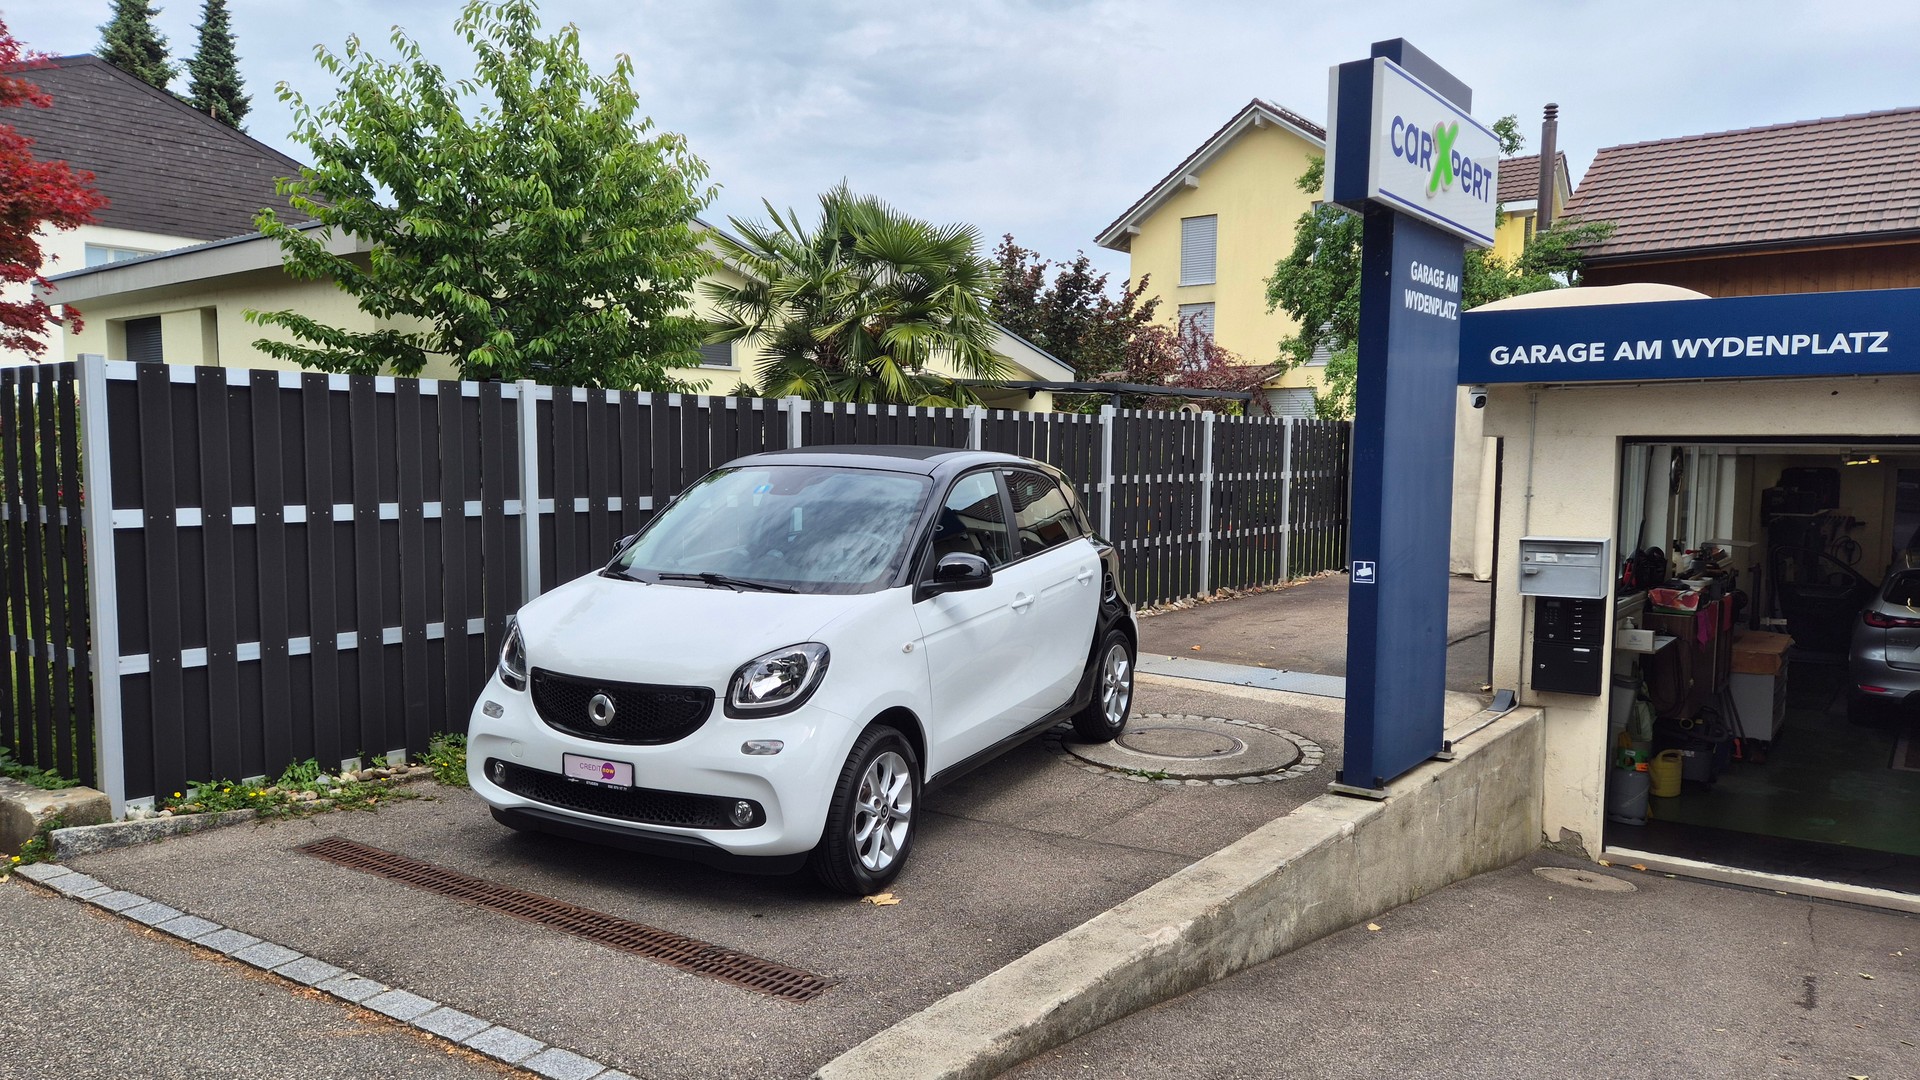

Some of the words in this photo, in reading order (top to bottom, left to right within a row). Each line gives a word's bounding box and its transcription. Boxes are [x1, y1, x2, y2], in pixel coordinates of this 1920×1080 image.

[1411, 261, 1445, 289] GARAGE
[1445, 273, 1459, 293] AM
[1405, 289, 1458, 320] WYDENPLATZ
[1490, 343, 1605, 365] GARAGE
[1613, 340, 1663, 361] AM
[1672, 331, 1889, 359] WYDENPLATZ
[579, 762, 601, 772] CREDIT
